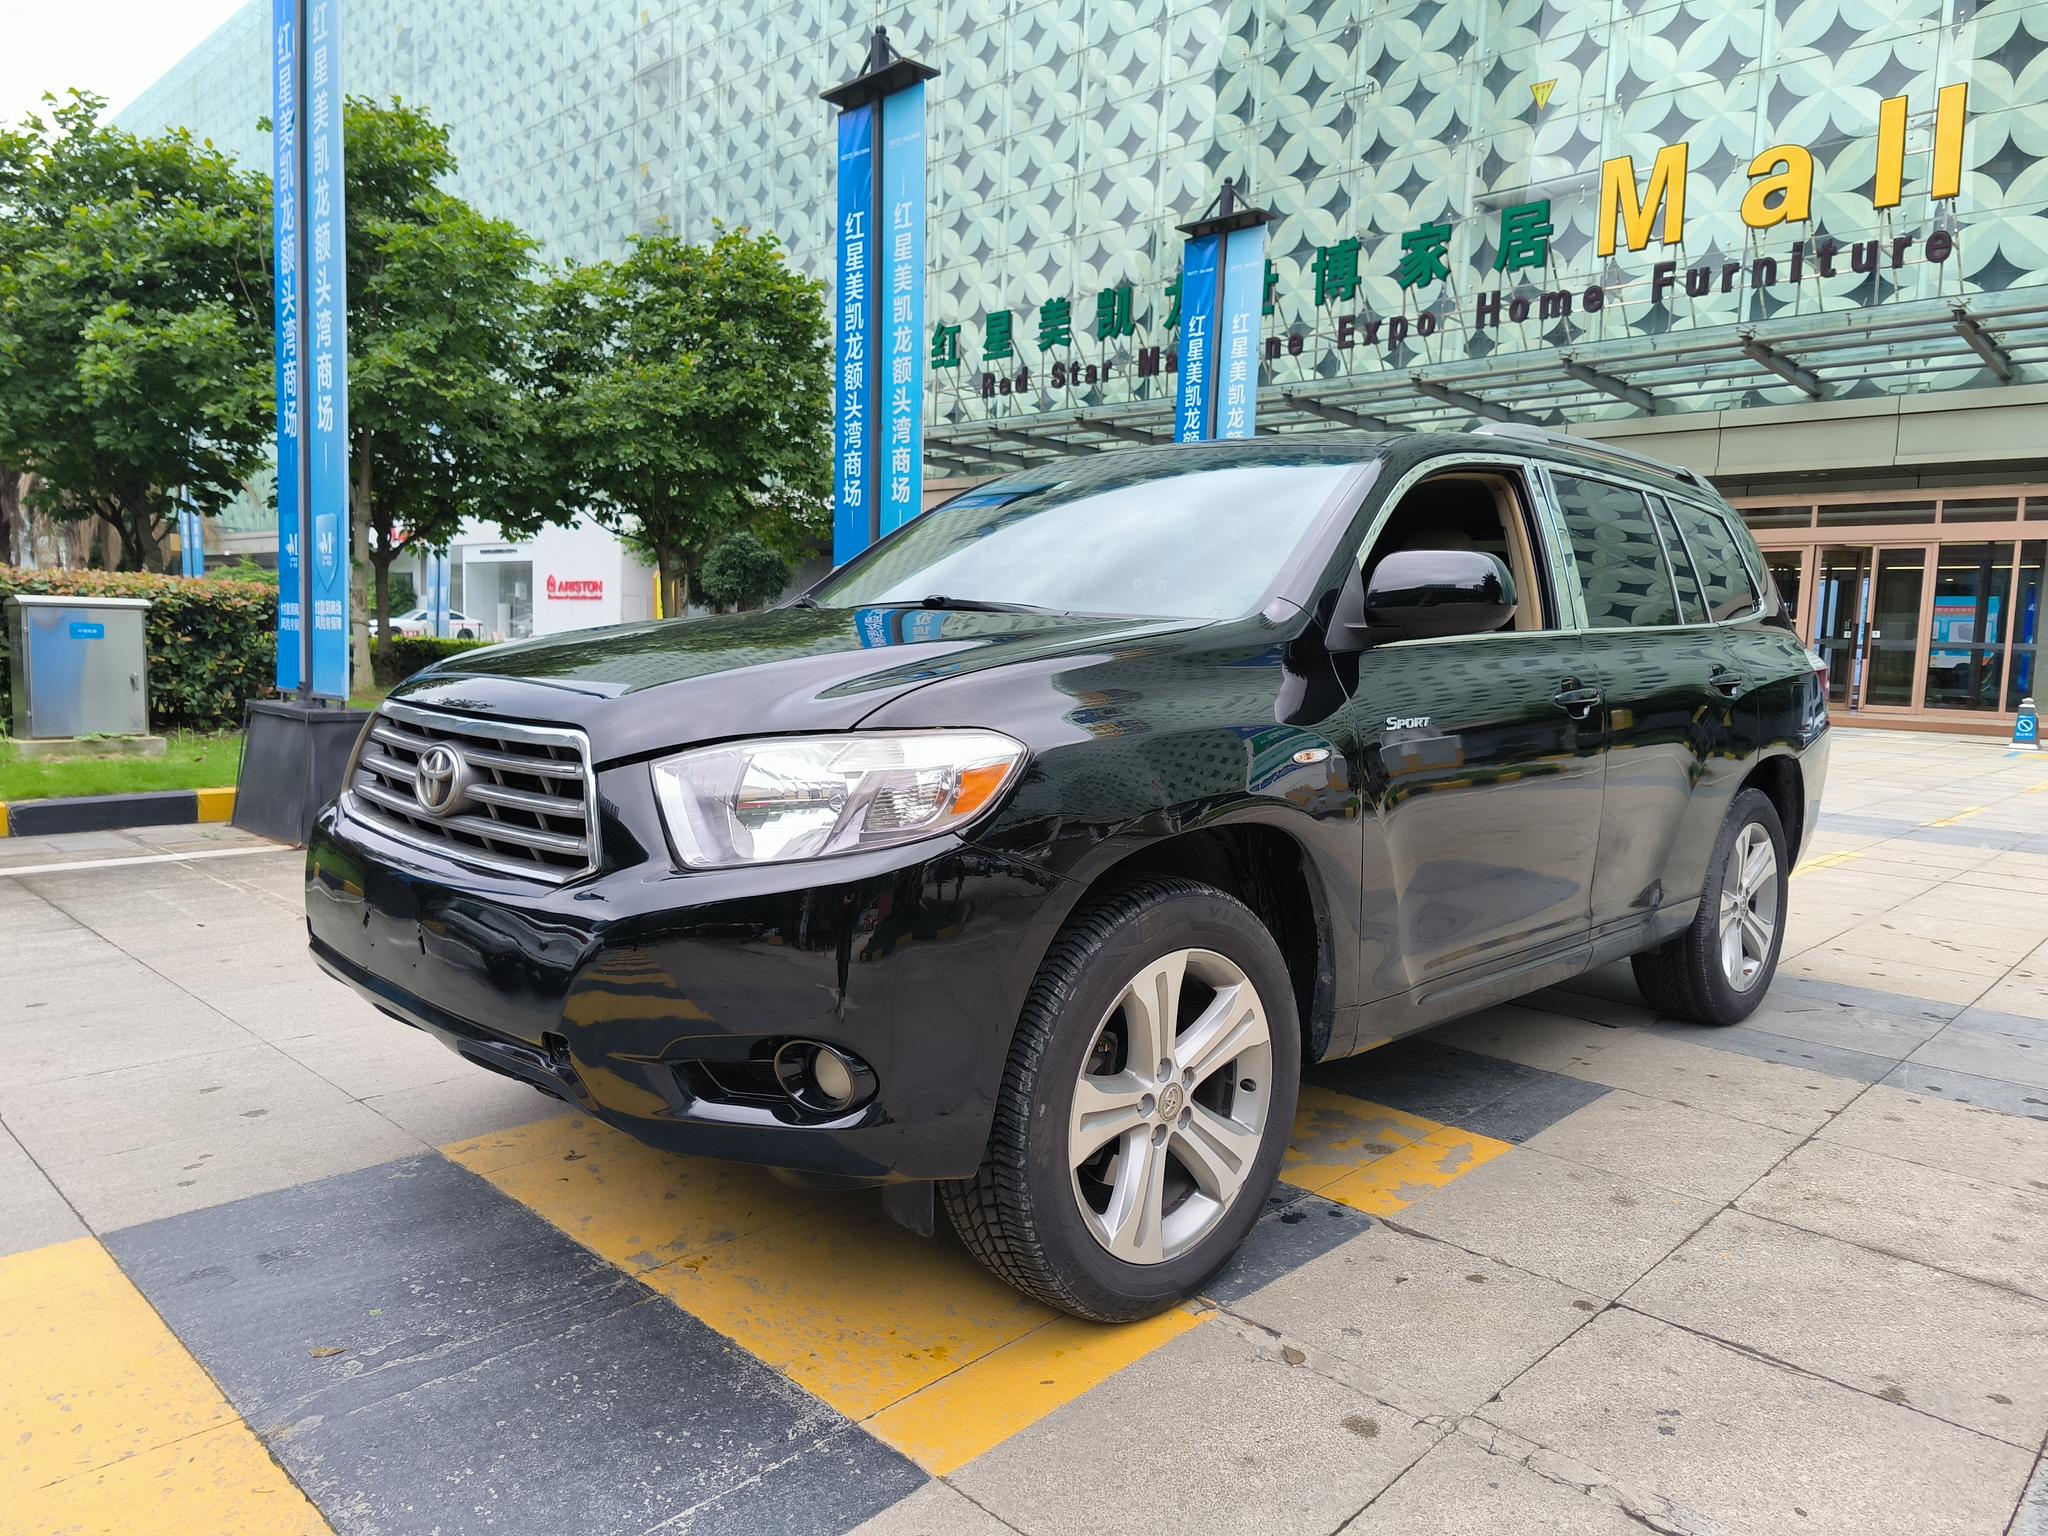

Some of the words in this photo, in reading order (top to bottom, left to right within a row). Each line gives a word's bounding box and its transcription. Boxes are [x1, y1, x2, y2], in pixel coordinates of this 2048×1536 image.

[277, 21, 297, 438] 红星美凯龙额头湾商场
[312, 2, 333, 432] 红星美凯龙额头湾商场
[982, 365, 1029, 399] Red
[1052, 360, 1112, 389] Star
[1337, 311, 1436, 351] Expo
[1475, 285, 1604, 330] Home
[1651, 230, 1951, 304] Furniture
[1597, 83, 1968, 258] Mall
[843, 211, 865, 508] 红星美凯龙额头湾商场
[891, 202, 913, 504] 红星美凯龙额头湾商场
[558, 581, 602, 593] ARISTON
